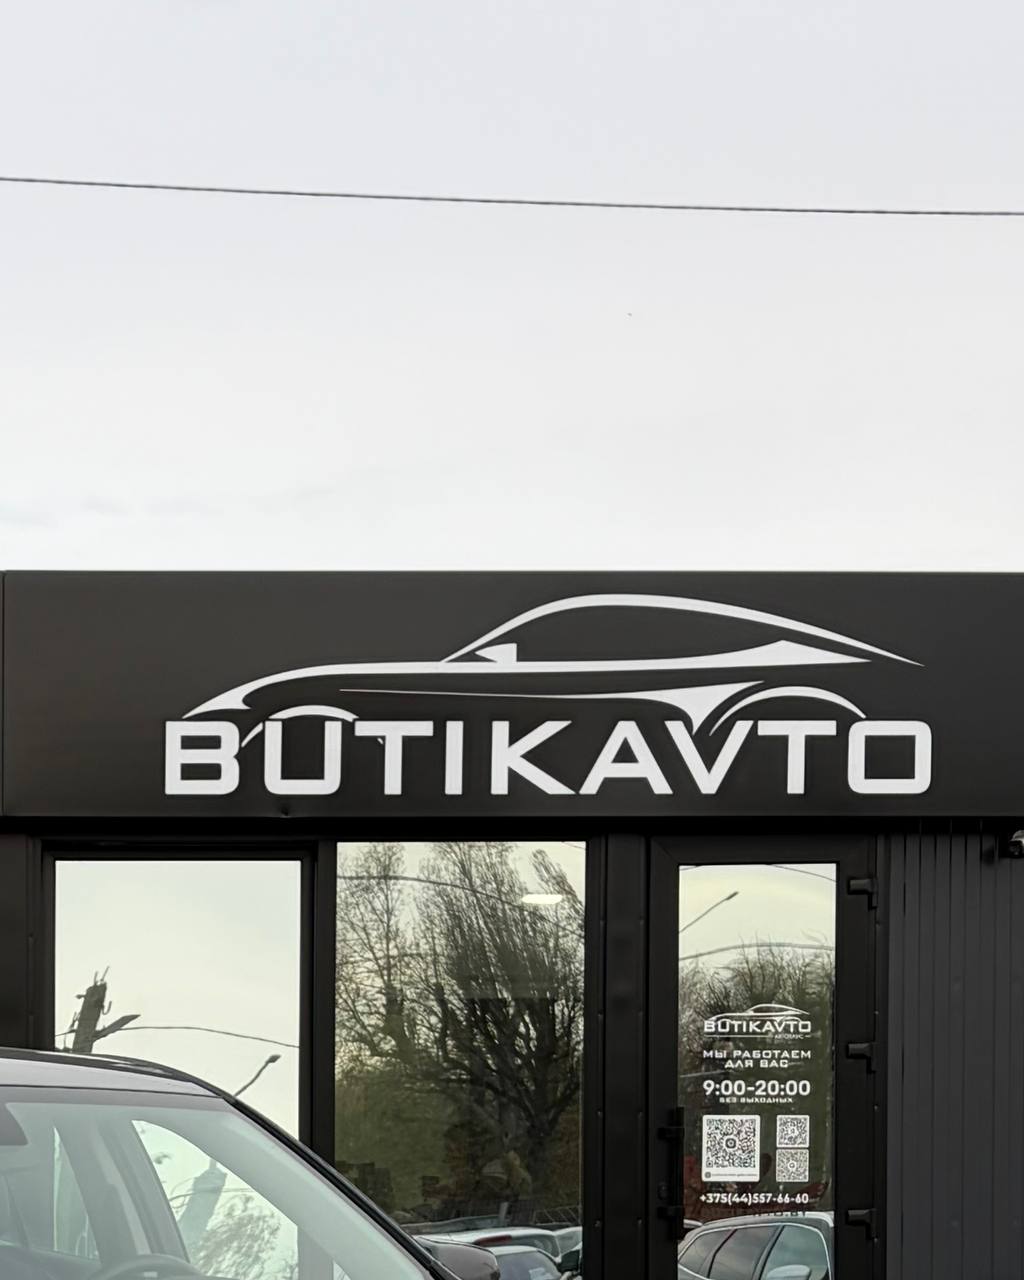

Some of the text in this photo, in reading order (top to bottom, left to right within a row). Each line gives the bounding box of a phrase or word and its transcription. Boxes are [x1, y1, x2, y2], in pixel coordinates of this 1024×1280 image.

[163, 718, 933, 797] BUTIKAVTO
[703, 1020, 812, 1033] BUTIKAVTO
[703, 1050, 811, 1059] МЫ РАБОТАЕМ
[724, 1059, 789, 1068] ДЛЯ ВАС
[702, 1079, 811, 1096] 9:00-20:00
[699, 1193, 810, 1206] +375(44)557-66-60
